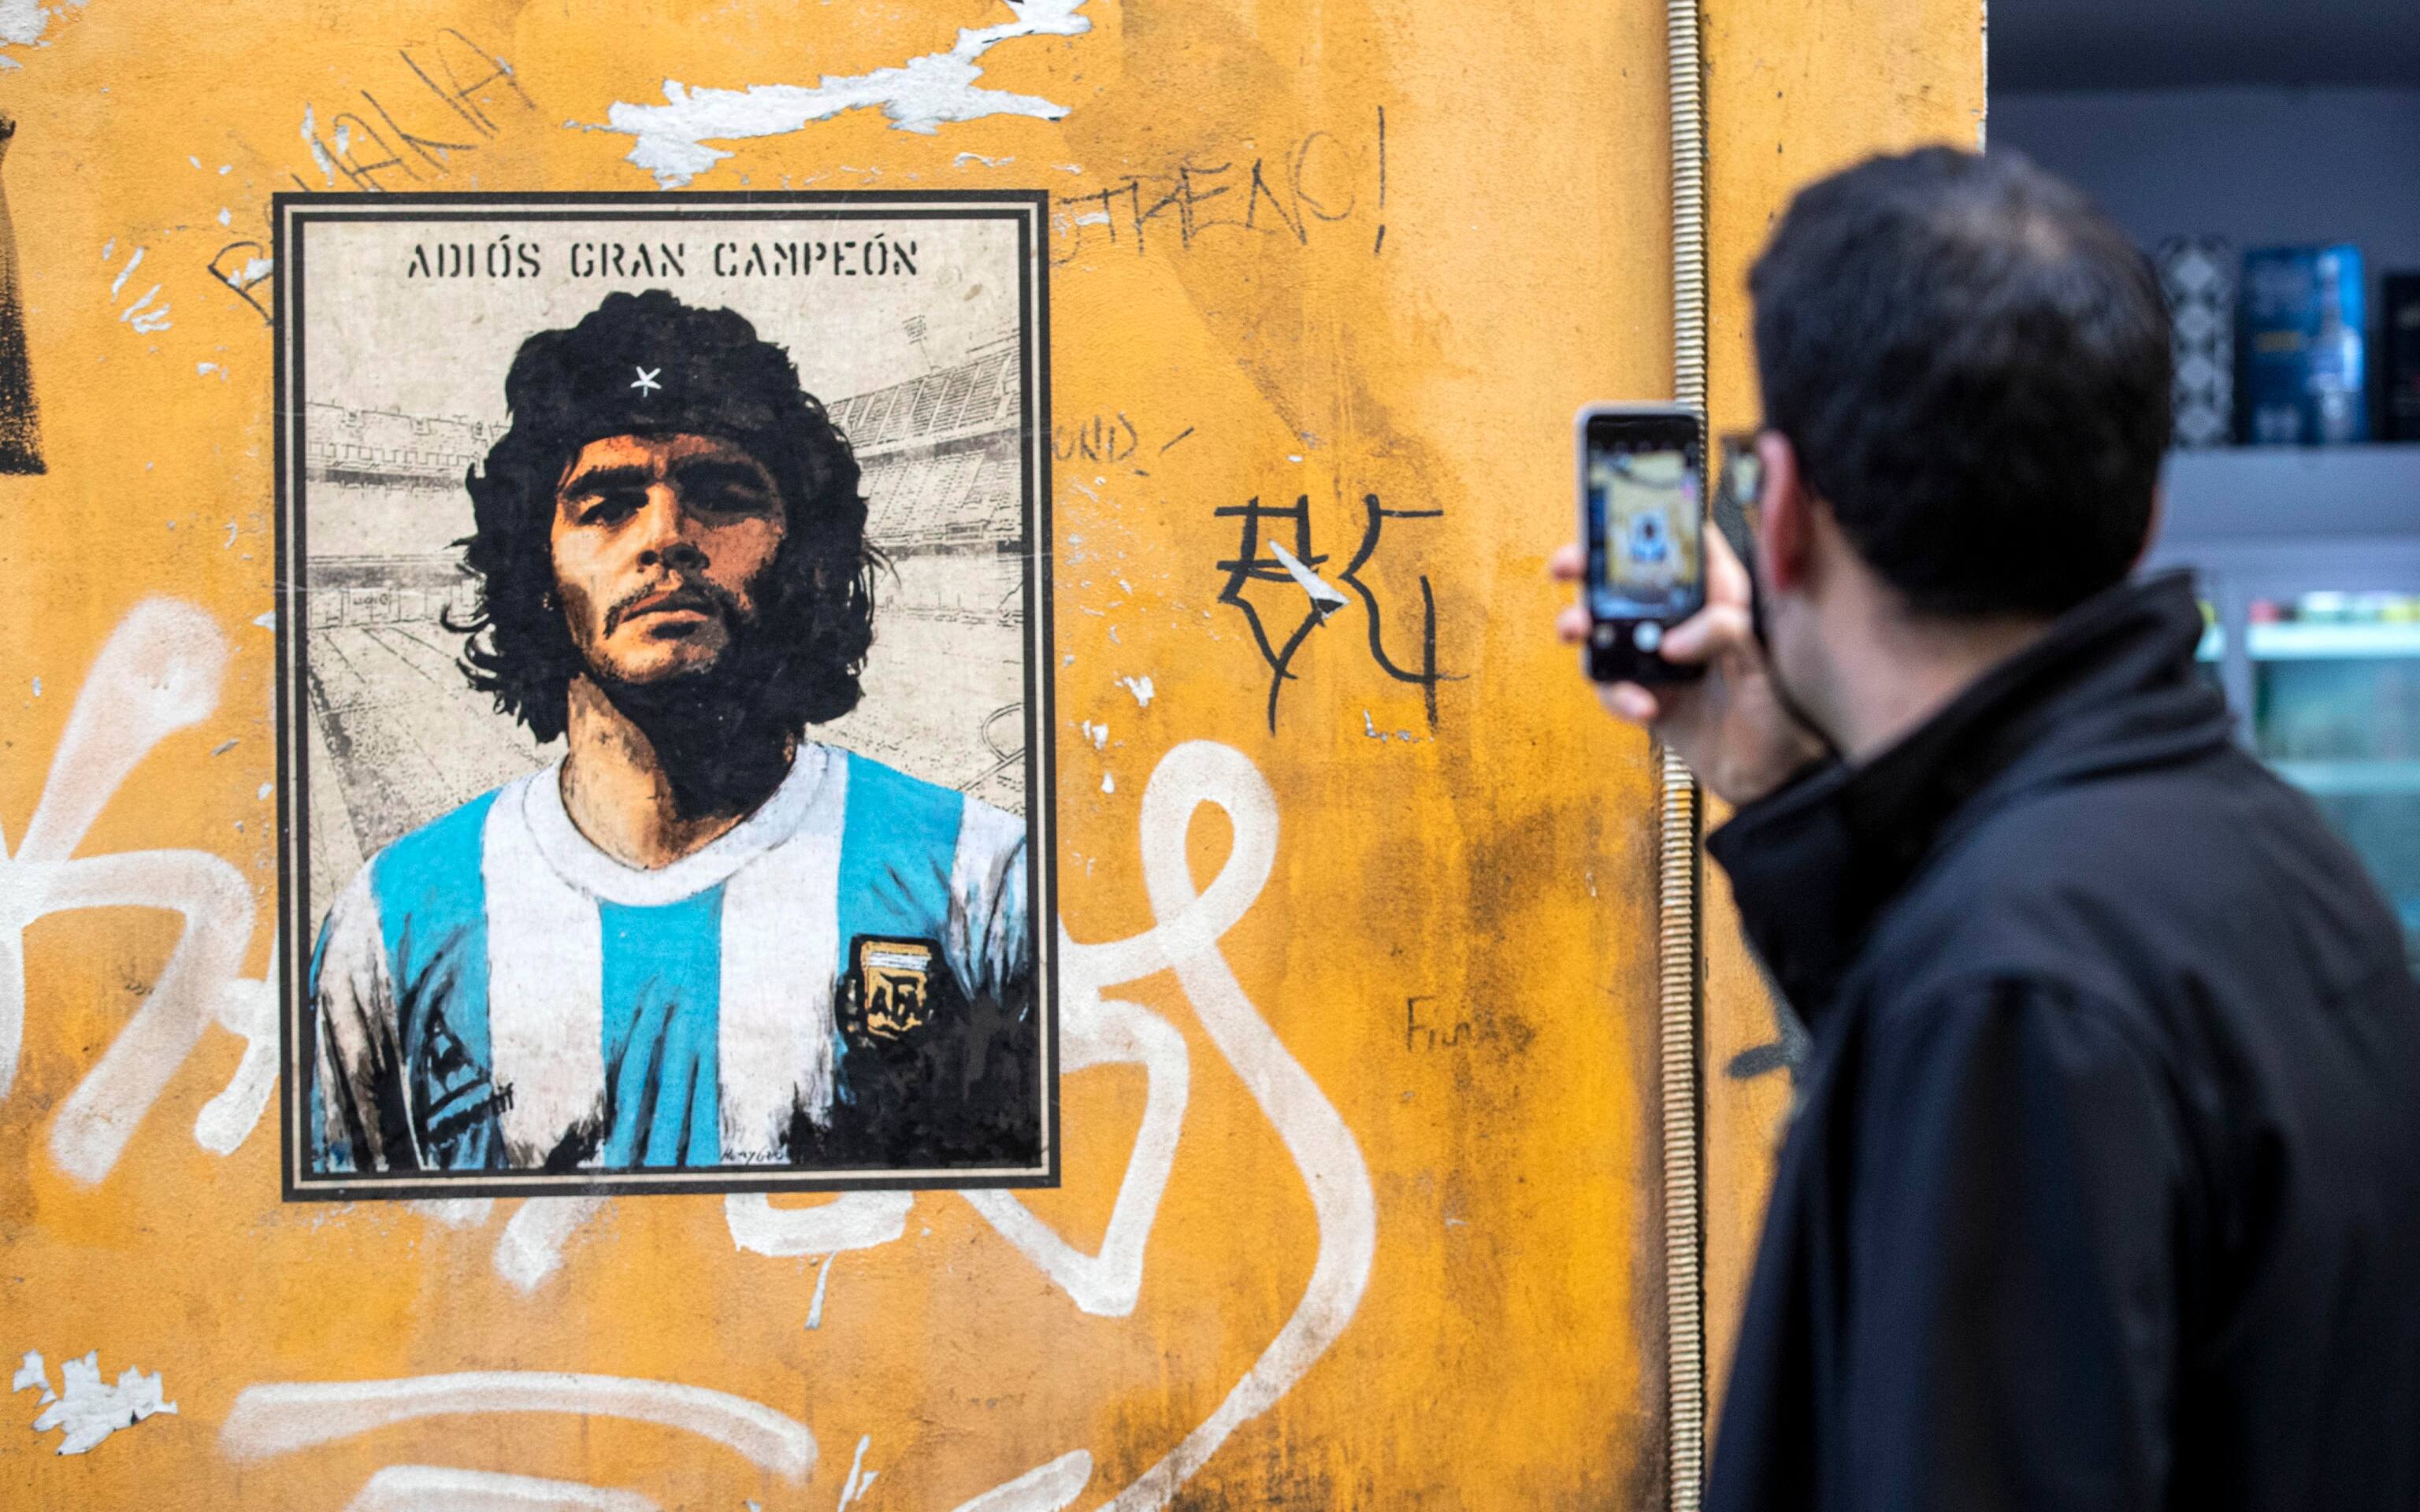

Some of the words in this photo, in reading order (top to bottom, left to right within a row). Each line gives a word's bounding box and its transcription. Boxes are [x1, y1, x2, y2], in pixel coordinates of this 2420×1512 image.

[409, 235, 540, 278] ADIÓS
[571, 243, 684, 277] GRAN
[715, 233, 917, 276] CAMPEÓN
